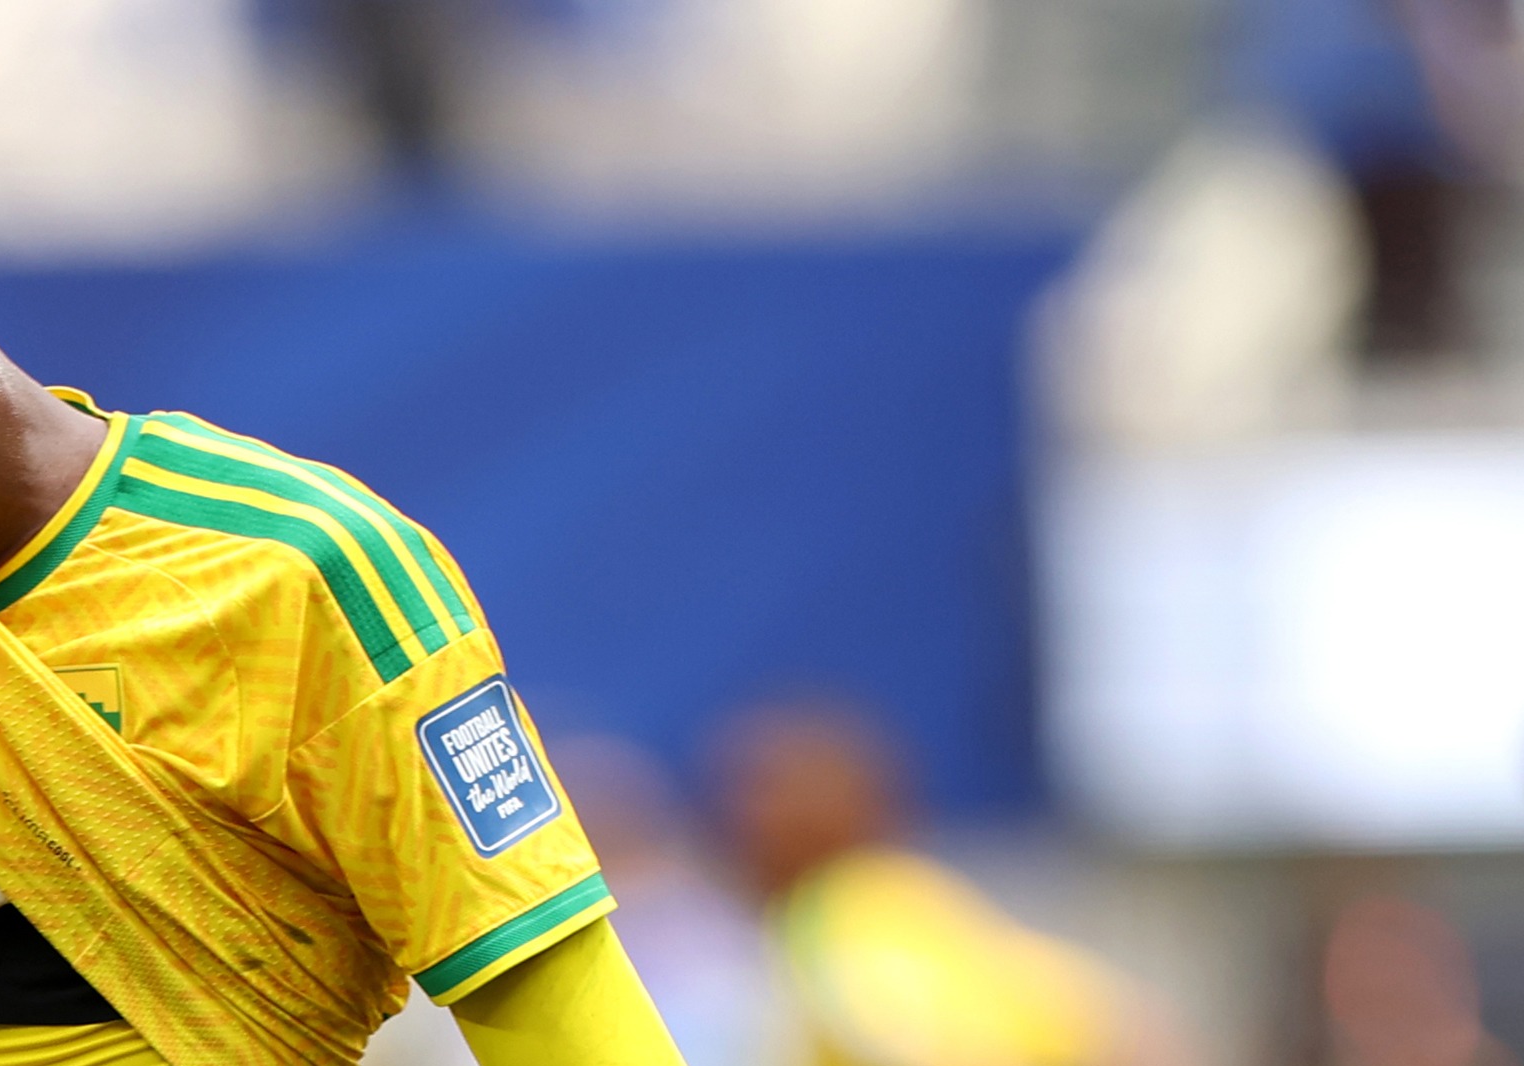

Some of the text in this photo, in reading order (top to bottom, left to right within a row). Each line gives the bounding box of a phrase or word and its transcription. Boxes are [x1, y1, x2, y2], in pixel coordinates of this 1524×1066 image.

[440, 705, 506, 755] FOOTBALL
[452, 726, 518, 784] UNITES
[466, 755, 534, 813] the World
[496, 797, 524, 819] FIFA
